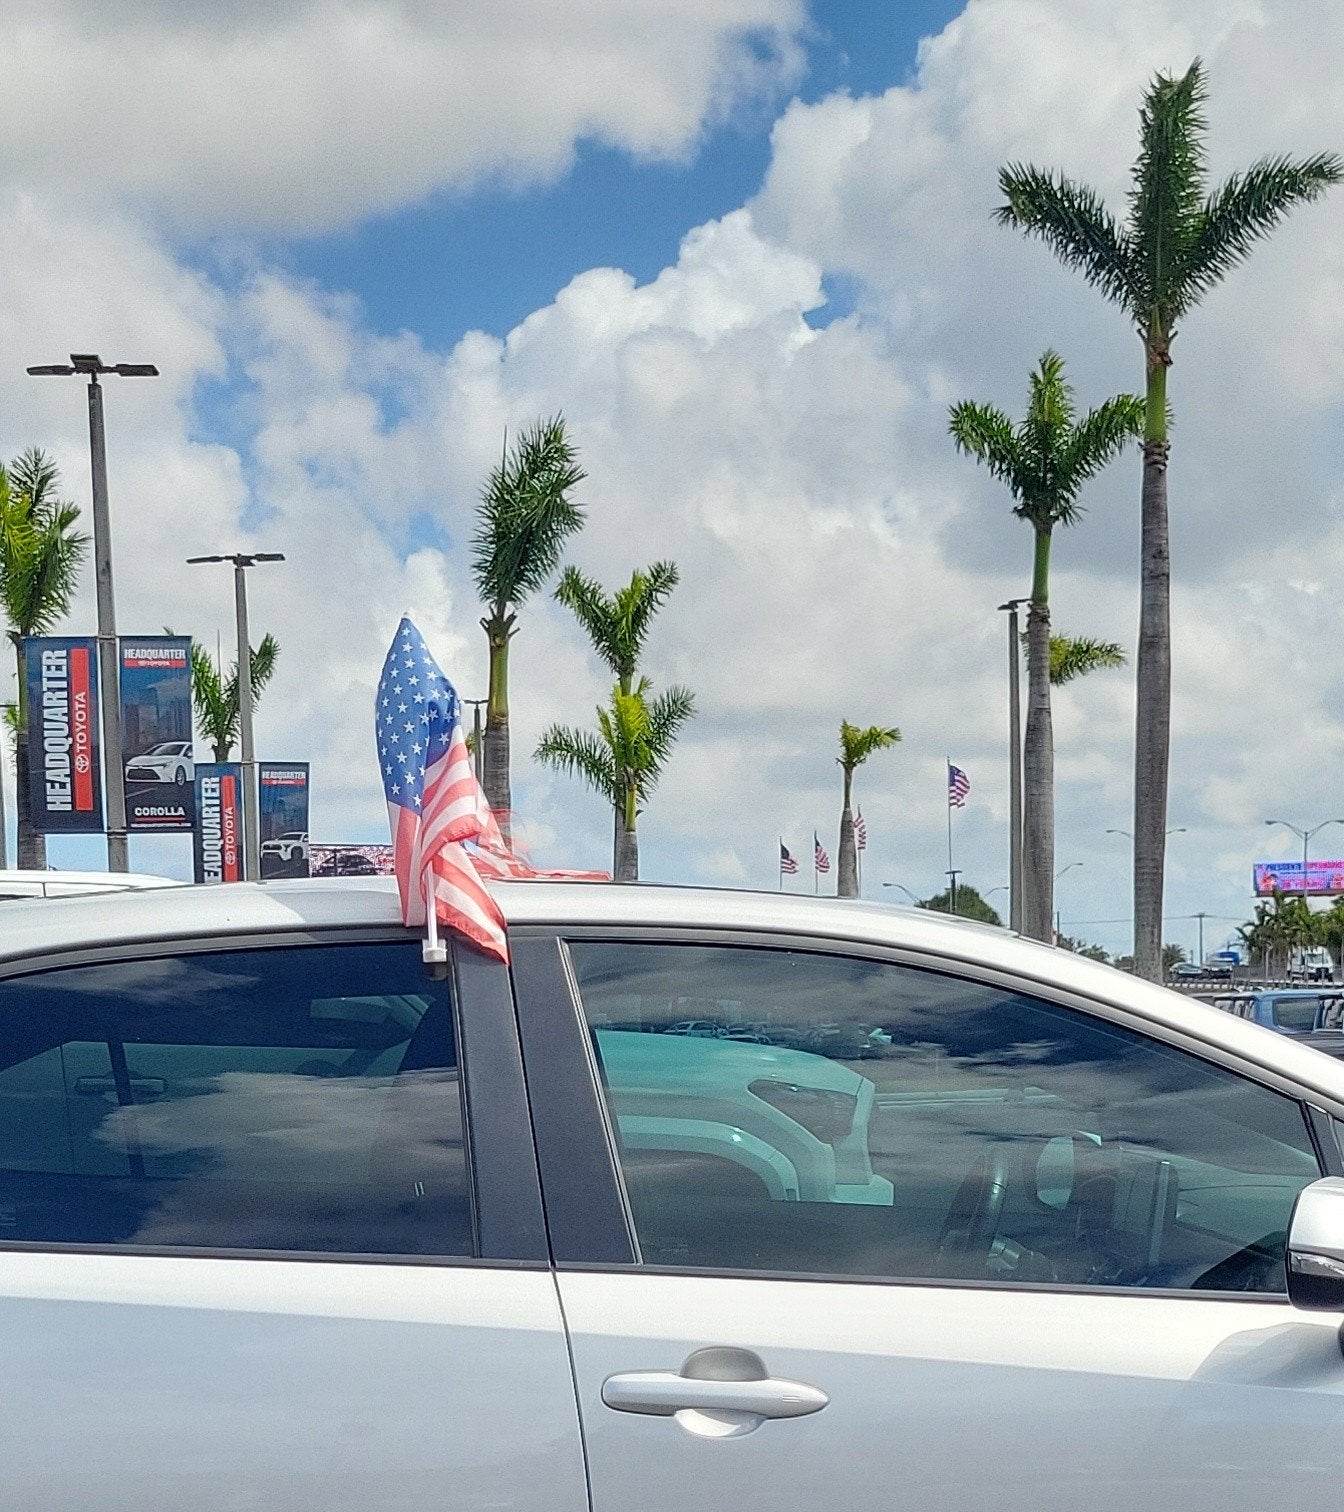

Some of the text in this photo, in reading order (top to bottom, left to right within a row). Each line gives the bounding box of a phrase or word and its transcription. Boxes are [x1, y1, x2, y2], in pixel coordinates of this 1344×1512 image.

[124, 649, 186, 660] HEADQUARTER
[42, 649, 73, 812] HEADQUARTER
[73, 691, 92, 754] TOYOTA
[134, 807, 186, 816] COROLLA
[201, 776, 223, 884] EADQUARTER
[224, 807, 235, 848] TOYOTA
